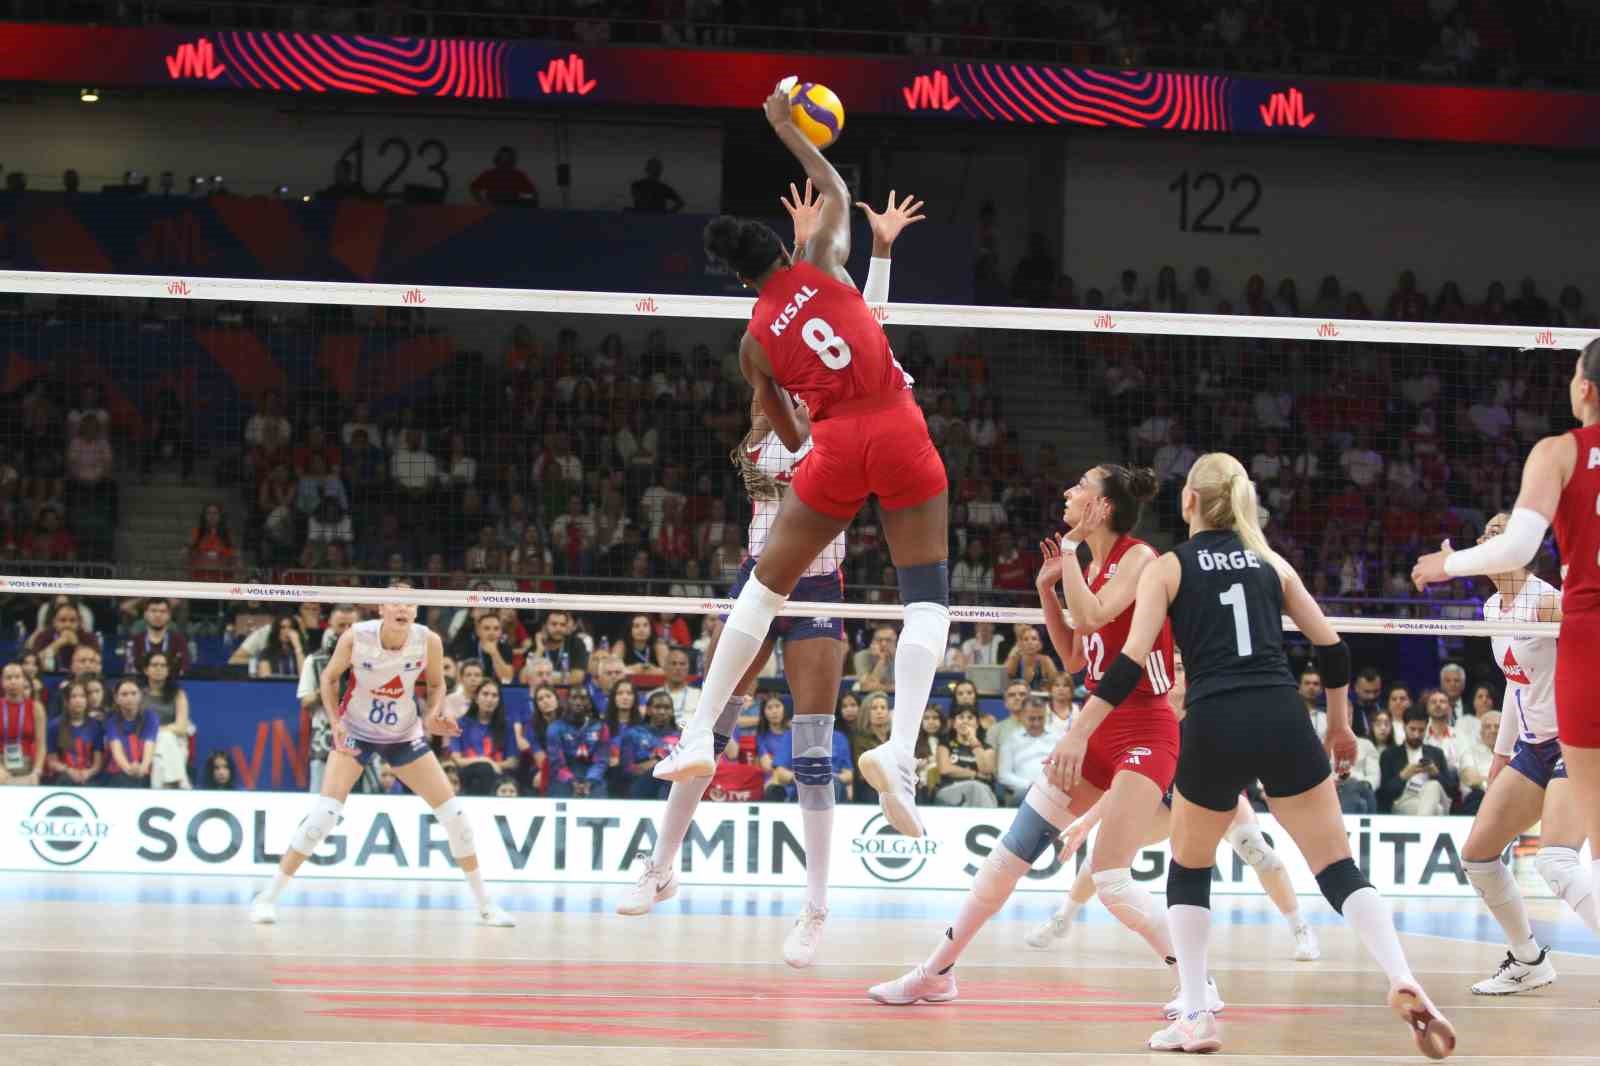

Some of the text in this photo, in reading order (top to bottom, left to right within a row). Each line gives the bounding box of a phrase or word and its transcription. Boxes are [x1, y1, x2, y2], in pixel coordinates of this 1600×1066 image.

[166, 38, 225, 79] VNL
[538, 54, 596, 94] VNL
[904, 70, 960, 110] VNL
[1260, 88, 1315, 128] VNL
[341, 136, 449, 199] 123
[1169, 171, 1262, 234] 122
[168, 280, 191, 295] VNL
[403, 288, 426, 304] VNL
[635, 297, 658, 314] VNL
[769, 285, 819, 336] KISAL
[1094, 313, 1117, 329] VNL
[1317, 323, 1340, 337] VNL
[801, 317, 851, 370] 8
[1536, 330, 1557, 346] VNL
[1197, 550, 1261, 571] ÖRGE
[9, 581, 63, 589] VOLLEYBALL
[247, 588, 301, 596] VOLLEYBALL
[482, 595, 537, 603] VOLLEYBALL
[949, 610, 999, 618] VOLLEYBALL
[1219, 583, 1252, 657] 1
[369, 698, 399, 725] 86
[19, 819, 109, 838] SOLGAR
[852, 838, 937, 855] SOLGAR
